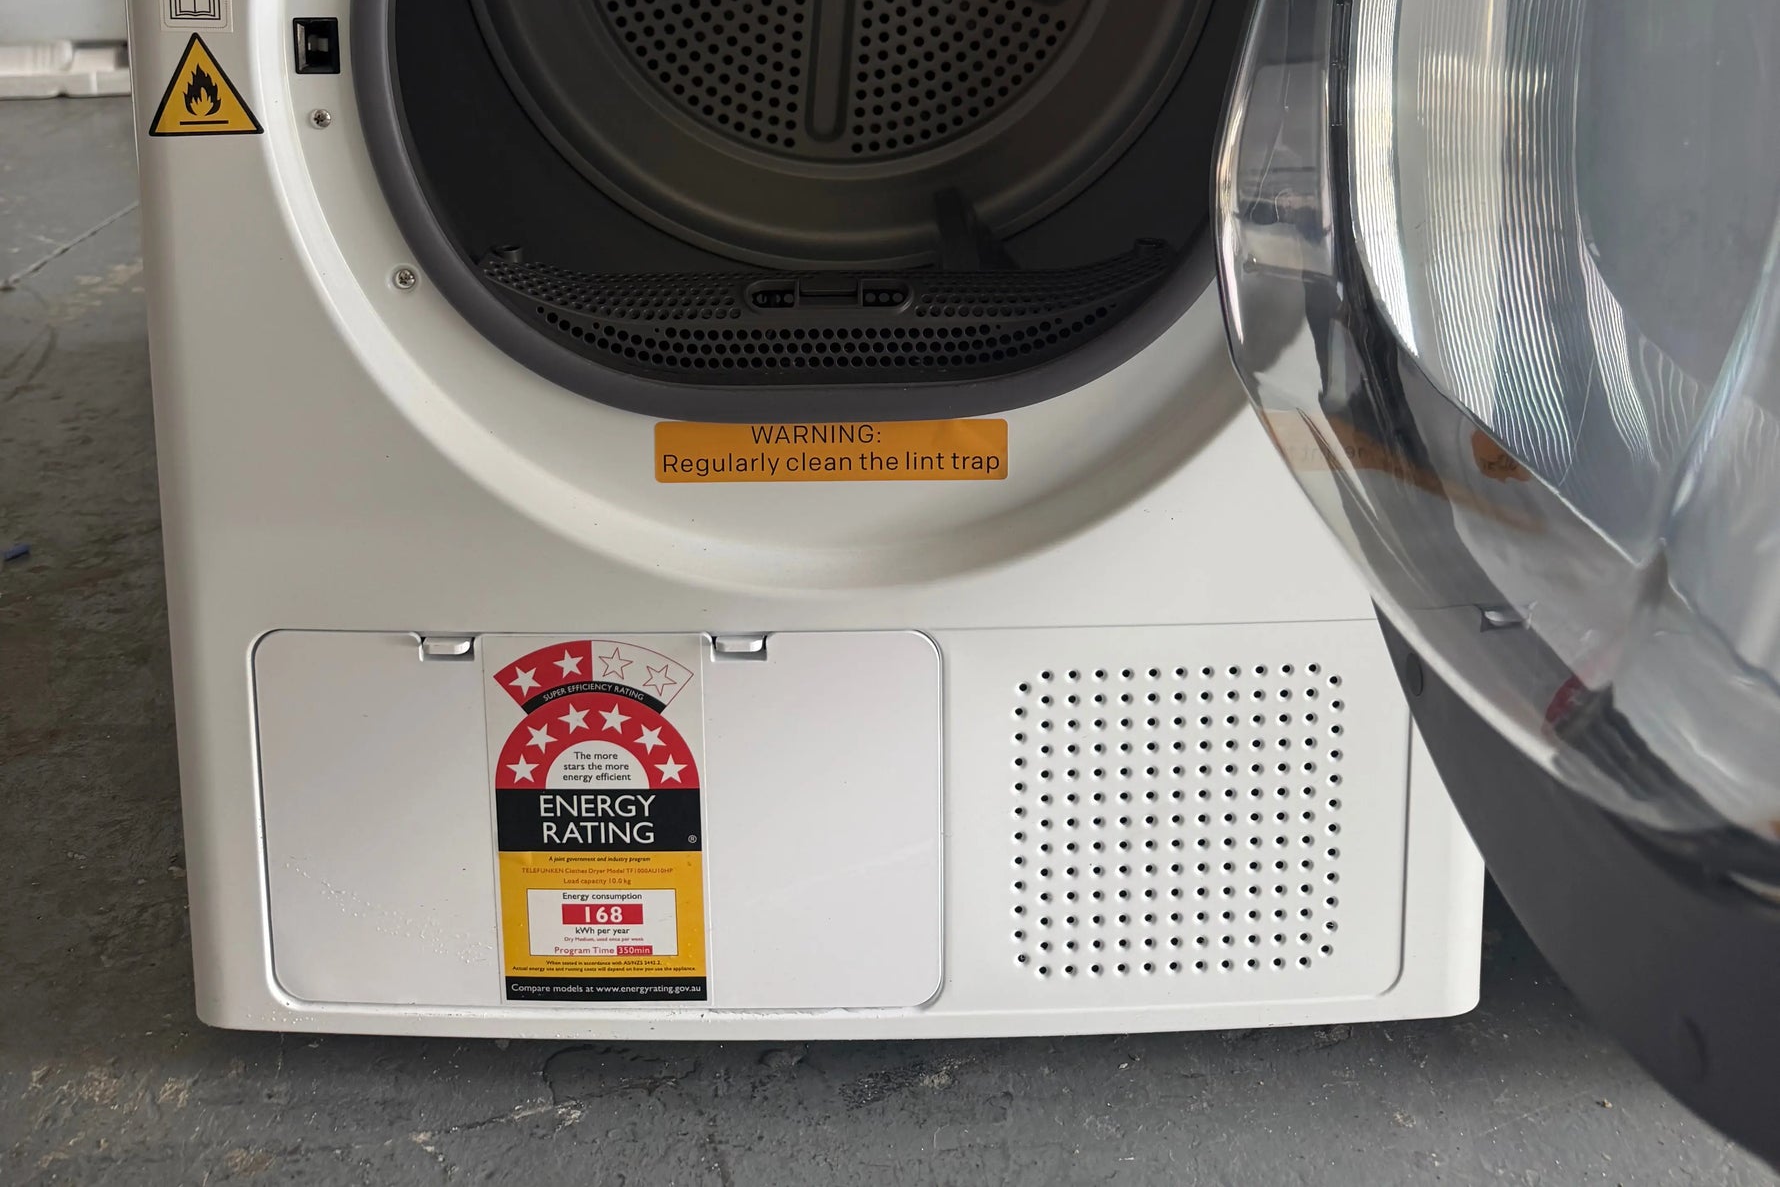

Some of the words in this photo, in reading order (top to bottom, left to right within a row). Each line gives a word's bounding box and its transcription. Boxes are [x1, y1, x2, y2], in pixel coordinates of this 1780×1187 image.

[750, 424, 881, 445] WARNING:
[663, 452, 780, 477] Regularly
[786, 453, 852, 472] clean
[859, 451, 898, 471] the
[905, 450, 944, 470] lint
[951, 452, 1000, 474] trap
[542, 688, 567, 702] SUPER
[567, 682, 613, 692] EFFICIENCY
[613, 685, 645, 702] RATING
[573, 751, 592, 760] The
[563, 763, 585, 771] stars
[588, 762, 603, 771] the
[605, 763, 630, 771] more
[562, 774, 593, 783] energy
[595, 772, 632, 781] efficient
[539, 794, 656, 818] ENERGY
[543, 821, 655, 844] RATING
[581, 878, 607, 886] capacity
[623, 877, 632, 885] kg
[562, 892, 589, 901] Energy
[591, 892, 642, 901] consumption
[583, 906, 624, 923] 168
[575, 926, 596, 935] kWh
[597, 928, 611, 936] per
[612, 928, 630, 936] year
[554, 946, 591, 955] Program
[592, 946, 615, 954] Time
[617, 946, 651, 954] 350min
[511, 983, 551, 994] Compare
[552, 984, 583, 993] models
[585, 985, 594, 993] at
[595, 984, 701, 995] www.energyrating.gov.au
